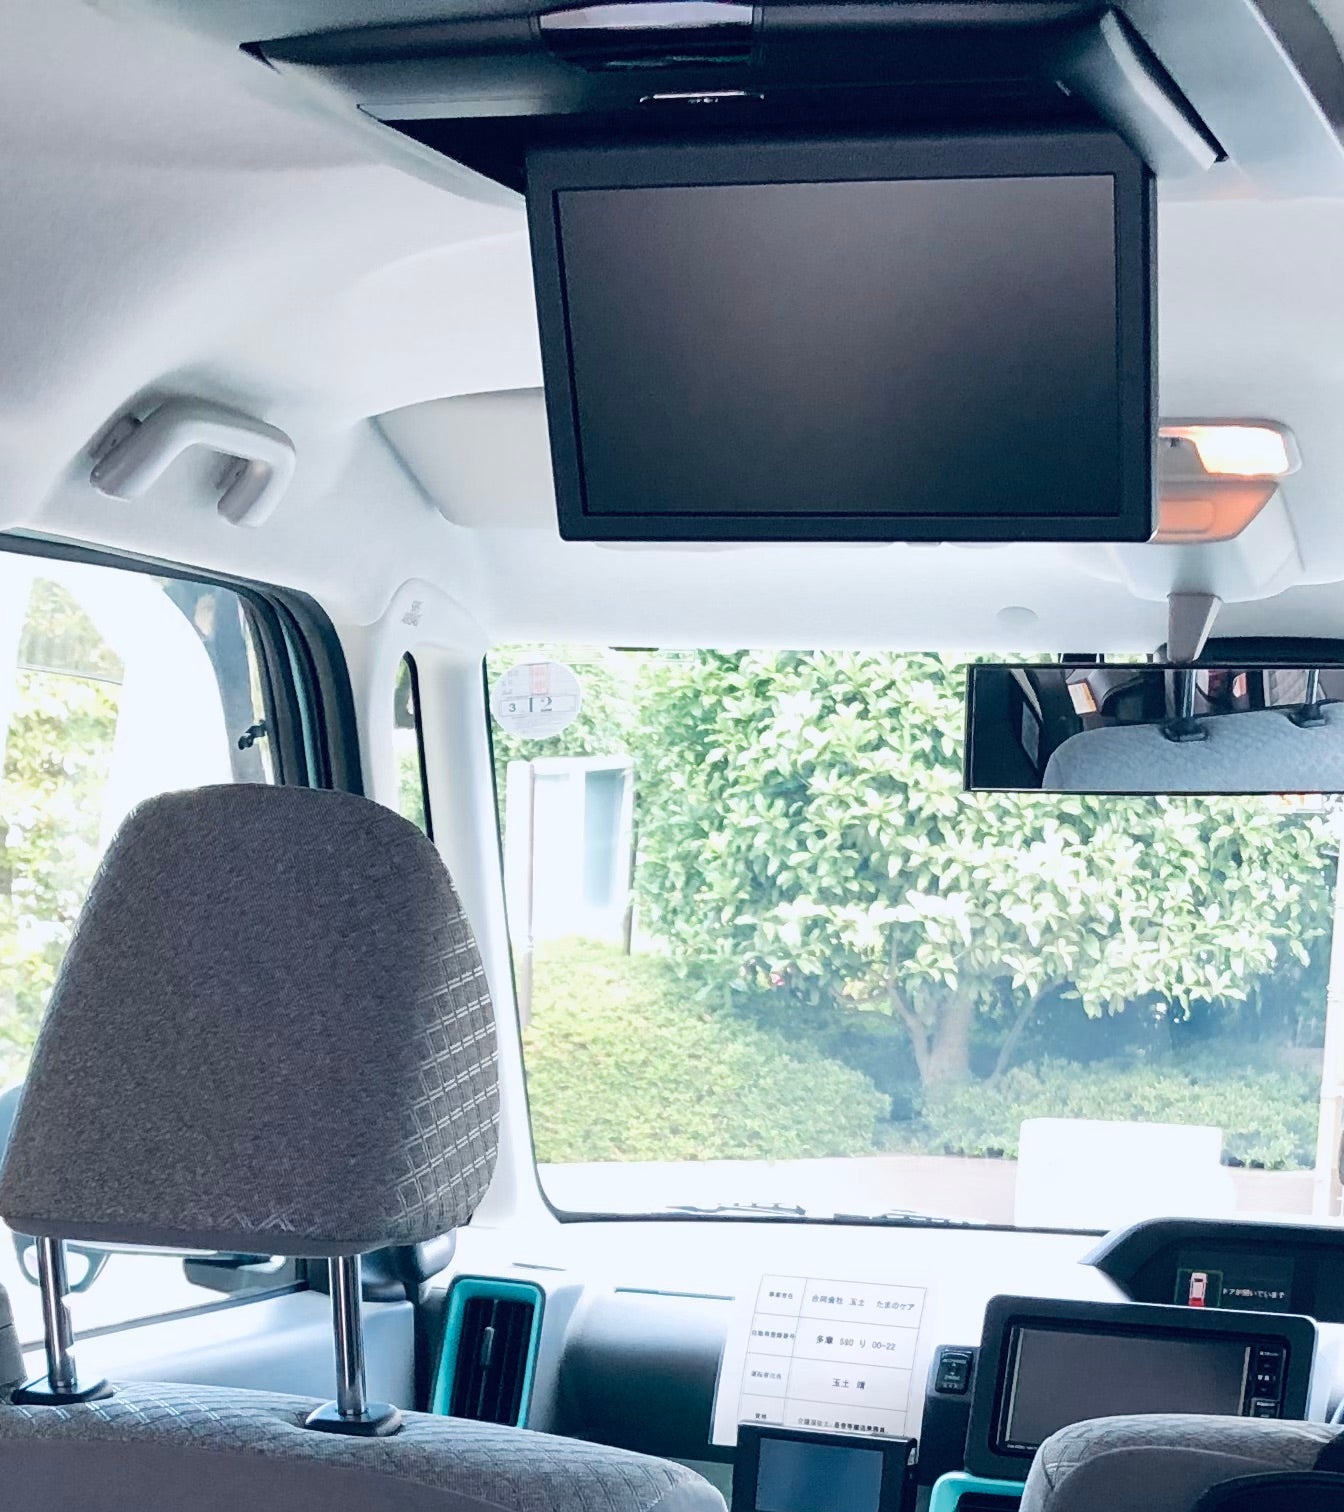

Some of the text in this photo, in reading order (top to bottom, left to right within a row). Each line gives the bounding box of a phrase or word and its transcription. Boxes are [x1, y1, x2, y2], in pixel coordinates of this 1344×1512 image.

[811, 1294, 843, 1305] 合同会社
[876, 1300, 915, 1311] たまのケア
